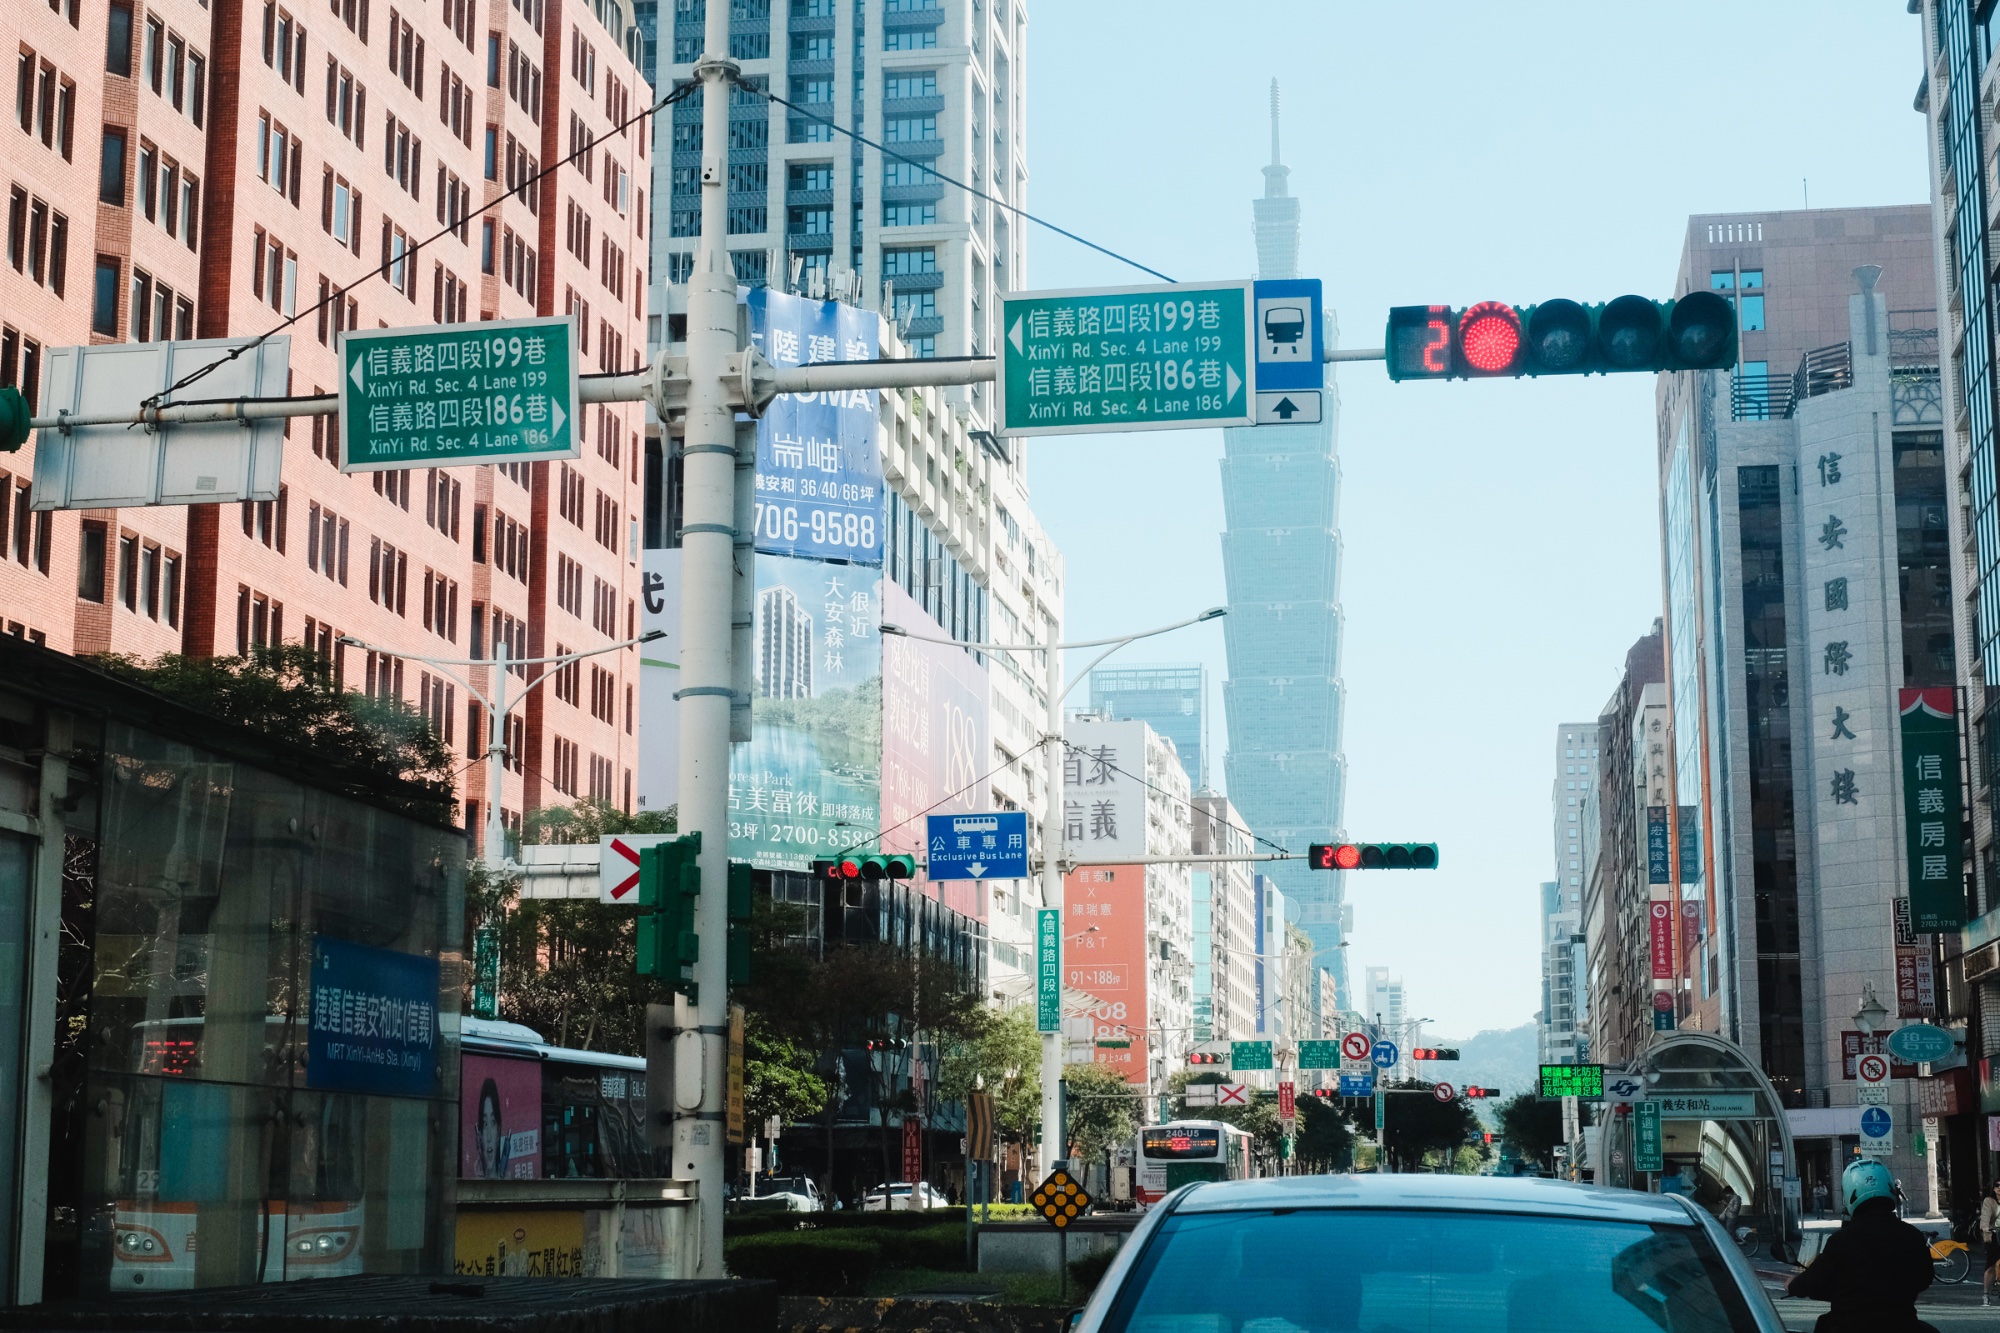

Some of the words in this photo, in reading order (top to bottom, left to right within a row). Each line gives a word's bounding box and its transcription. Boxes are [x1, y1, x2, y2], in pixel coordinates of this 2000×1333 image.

[1028, 300, 1221, 338] 信義路四段199巷
[752, 329, 869, 363] 陸建設
[1028, 344, 1065, 360] XinYi
[1072, 342, 1094, 358] Rd.
[1100, 340, 1130, 357] Sec.
[1136, 340, 1147, 355] 4
[1153, 338, 1189, 354] Lane
[1195, 336, 1221, 352] 199
[1424, 320, 1448, 352] 2
[367, 336, 546, 377] 信義路四段199巷
[368, 381, 403, 398] XinYi
[409, 380, 429, 396] Rd.
[435, 378, 463, 393] Sec.
[468, 377, 478, 391] 4
[484, 375, 516, 390] Lane
[522, 371, 547, 387] 199
[1028, 358, 1222, 397] 信義路四段186巷
[368, 394, 547, 433] 信義路四段186巷
[1028, 402, 1066, 419] XinYi
[1073, 401, 1095, 417] Rd.
[1101, 399, 1132, 416] Sec.
[1137, 398, 1148, 413] 4
[1154, 397, 1190, 413] Lane
[1196, 395, 1222, 411] 186
[370, 439, 404, 455] XinYi
[411, 437, 430, 452] Rd.
[436, 435, 464, 451] Sec.
[469, 434, 479, 448] 4
[485, 431, 518, 447] Lane
[523, 428, 548, 445] 186
[801, 479, 874, 503] 36/40/66坪
[823, 576, 845, 674] 大安森林
[850, 590, 870, 639] 很近
[1817, 451, 1860, 807] 信安國際大樓
[944, 700, 977, 811] 188
[1064, 744, 1118, 786] 首泰
[764, 770, 793, 787] Park
[822, 802, 875, 821] 即將落成
[1064, 799, 1118, 841] 信義
[1915, 754, 1948, 881] 信義房屋
[728, 822, 759, 841] 3坪
[770, 824, 875, 849] 2700-8589
[931, 833, 1022, 851] 公車專用
[931, 851, 977, 862] Exclusive
[979, 851, 997, 860] Bus
[999, 851, 1022, 860] Lane
[1322, 847, 1333, 867] 2
[1079, 870, 1105, 882] 首泰
[1087, 888, 1096, 897] X
[1072, 903, 1112, 916] 陳瑞憲
[1920, 920, 1957, 928] 2702-1718
[1042, 919, 1056, 992] 信義路四段
[1898, 956, 1916, 1000] 本棟2樓
[314, 985, 434, 1050] 捷運信義安和站(信義)
[327, 1042, 345, 1061] MRT
[346, 1044, 384, 1064] XinYi-AnHe
[386, 1049, 400, 1066] Sta.
[401, 1050, 421, 1072] (Xinyi)
[1542, 1066, 1601, 1077] 閱讀臺北防災
[602, 1076, 626, 1098] 首都客運
[1166, 1130, 1199, 1138] 240-U5
[1641, 1117, 1655, 1154] 迴轉道
[528, 1246, 583, 1278] 不闖紅燈
